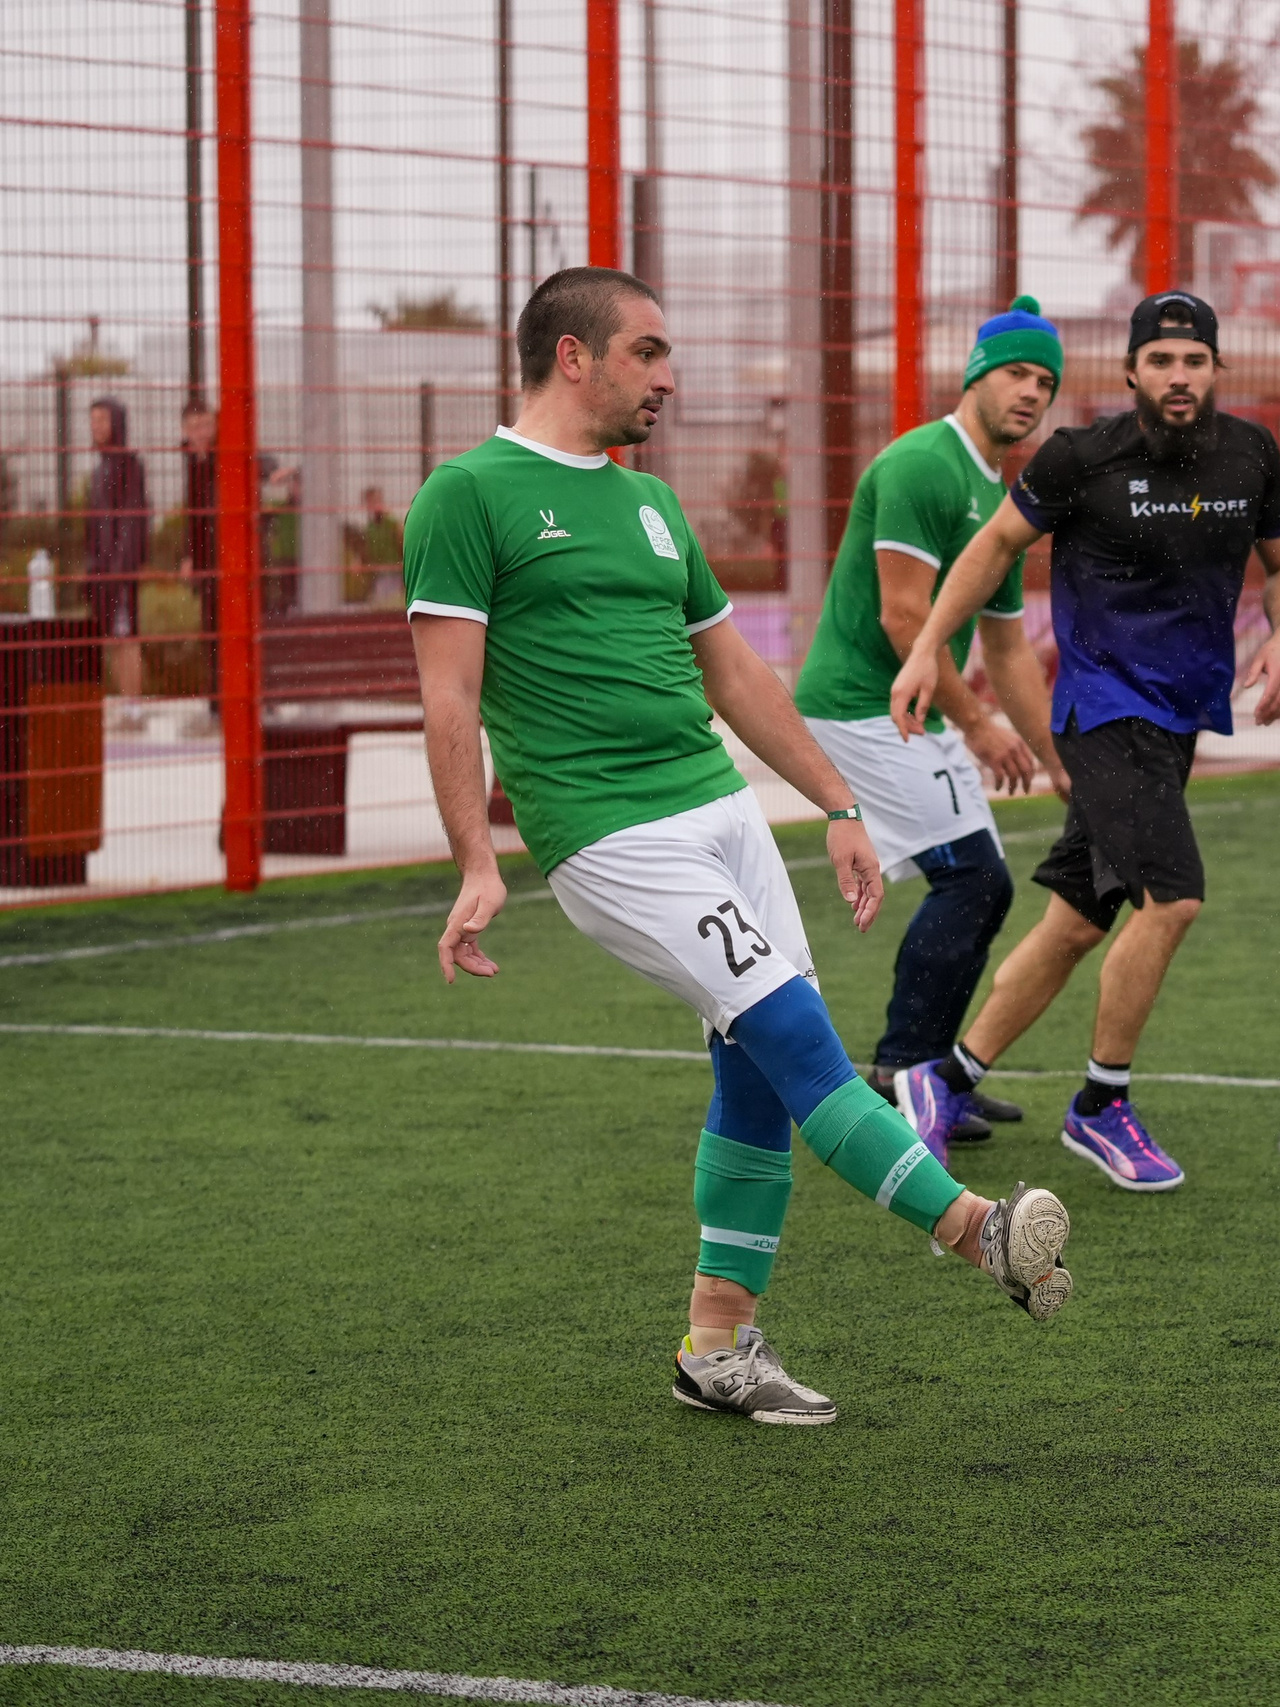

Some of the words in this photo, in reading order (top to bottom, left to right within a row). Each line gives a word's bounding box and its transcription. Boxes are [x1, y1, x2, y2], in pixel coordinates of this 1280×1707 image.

[537, 528, 572, 540] JÖGEL
[933, 769, 960, 815] 7
[697, 899, 772, 978] 23
[890, 1145, 928, 1191] JÖGEL
